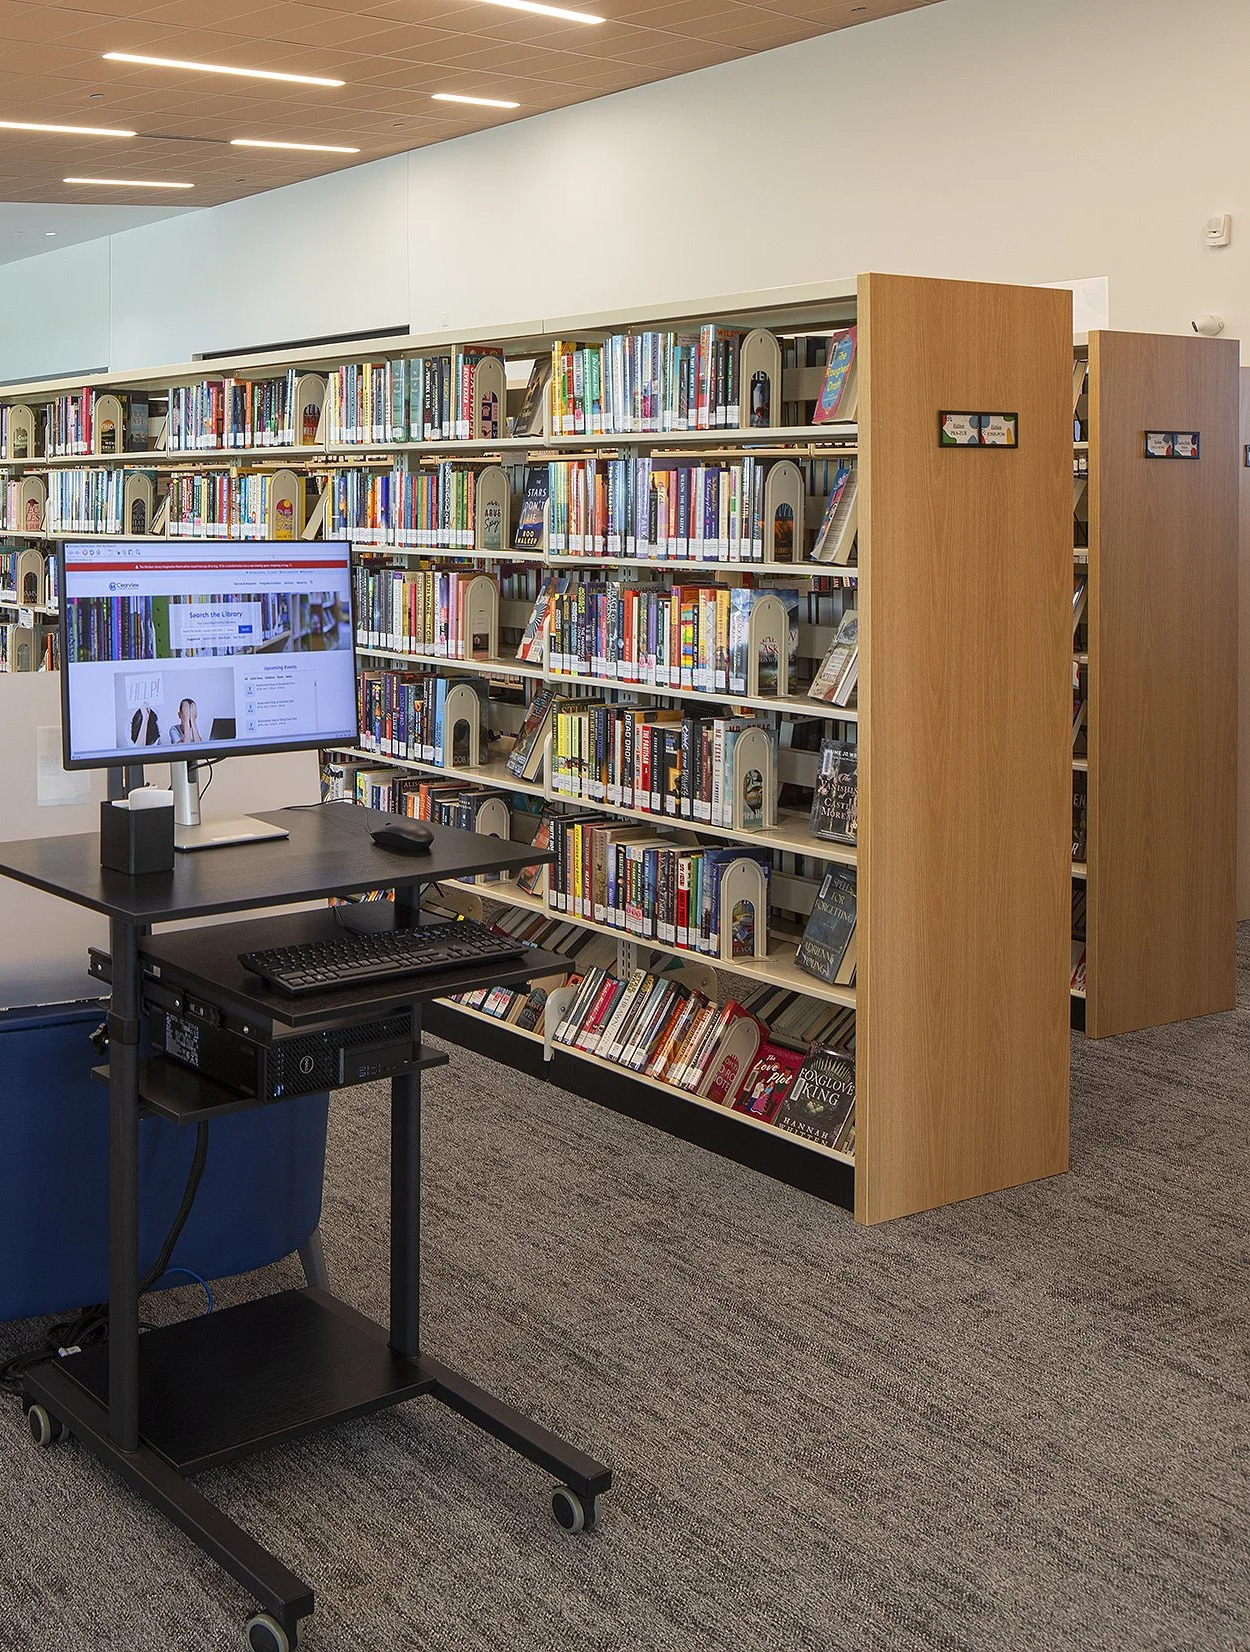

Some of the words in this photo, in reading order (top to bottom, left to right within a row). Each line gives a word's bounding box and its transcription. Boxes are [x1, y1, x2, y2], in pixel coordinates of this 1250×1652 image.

[837, 351, 847, 361] The
[679, 473, 687, 492] WILSON
[527, 488, 547, 497] STARS
[679, 495, 687, 504] THE
[524, 500, 545, 511] DON'T
[679, 505, 687, 517] SEED
[526, 513, 537, 523] LIE
[522, 530, 535, 538] BOO
[679, 518, 687, 535] KEEPER
[517, 537, 538, 545] WALKER
[610, 591, 618, 611] RAGE
[189, 611, 210, 619] Search
[222, 610, 243, 618] Library
[129, 678, 160, 701] HELP!
[624, 714, 632, 737] DEAD
[642, 729, 650, 739] THE
[714, 728, 722, 740] MR.
[624, 739, 632, 763] DROP
[642, 740, 650, 764] PARTISAN
[714, 741, 722, 762] TEXAS
[818, 776, 857, 796] VANISHIN
[837, 773, 851, 783] The
[714, 781, 722, 804] LAWRENCE
[821, 806, 857, 822] MOREAU
[833, 880, 855, 894] SPELLS
[830, 892, 846, 905] FOR
[815, 899, 855, 924] FORGETTING
[803, 940, 835, 965] ADRIENNE
[612, 992, 633, 1027] THRAWN
[753, 1059, 779, 1072] Love
[766, 1071, 793, 1085] Plot
[799, 1067, 855, 1097] FOXGLOVE
[802, 1082, 840, 1106] KING
[779, 1122, 829, 1147] WHITTEN
[783, 1116, 829, 1140] HANNAH
